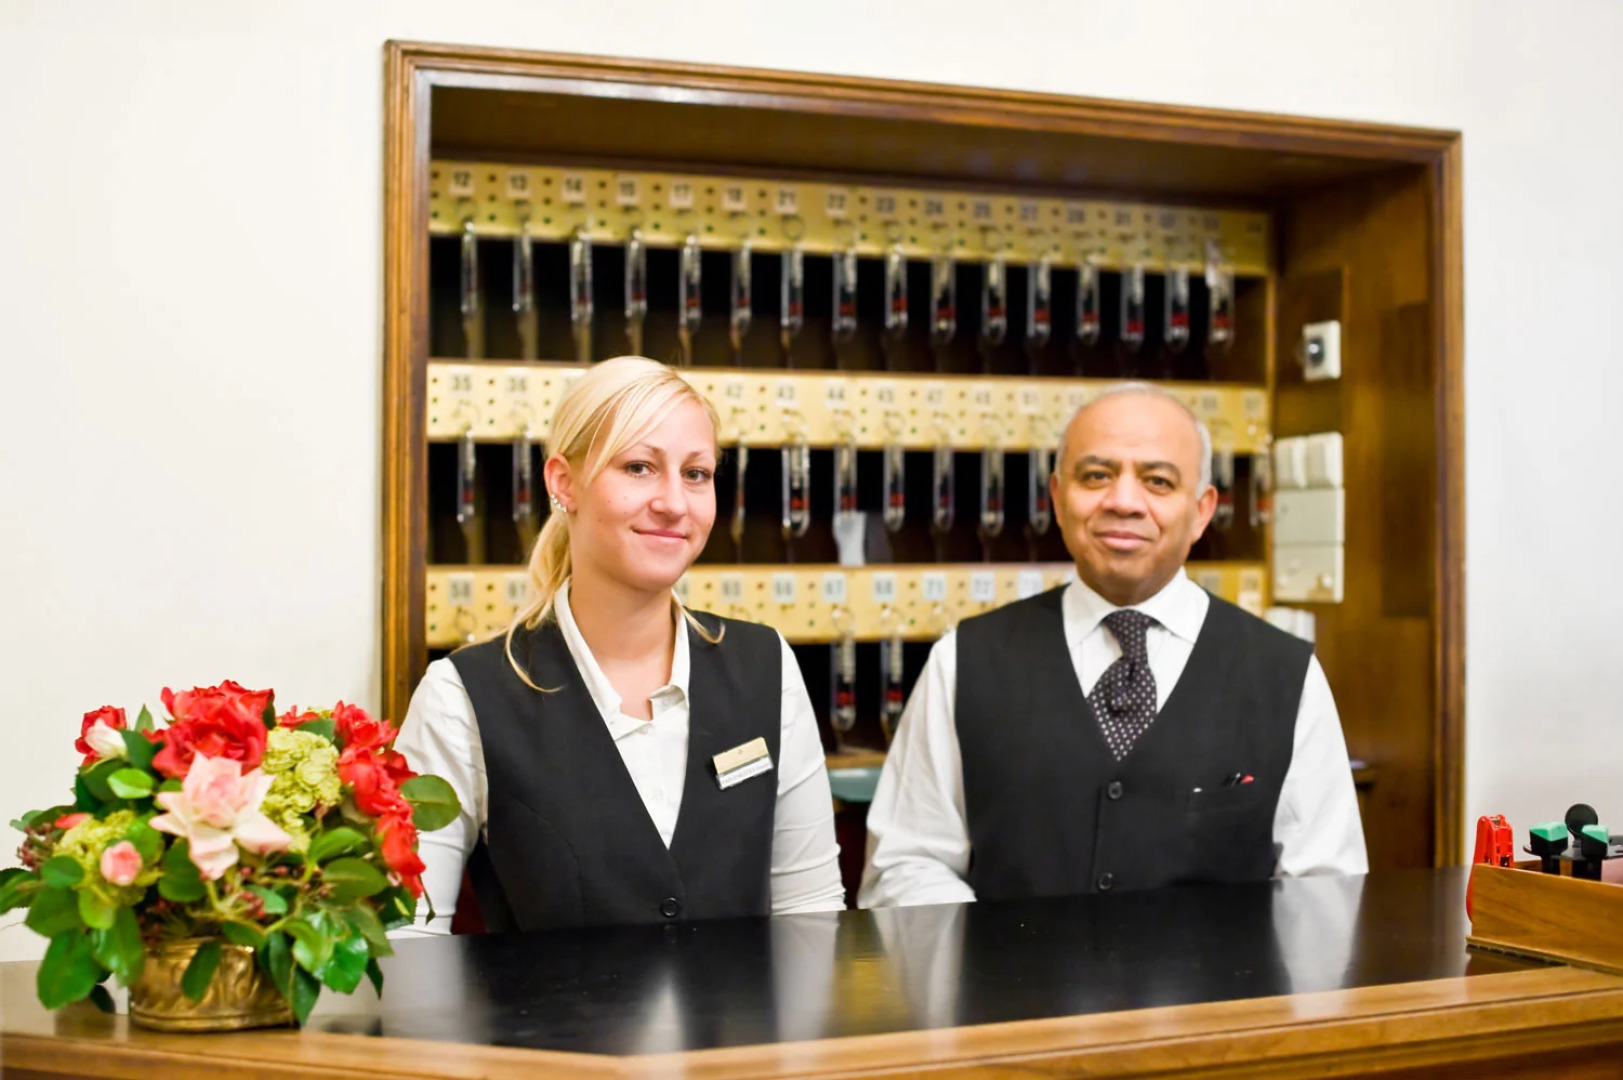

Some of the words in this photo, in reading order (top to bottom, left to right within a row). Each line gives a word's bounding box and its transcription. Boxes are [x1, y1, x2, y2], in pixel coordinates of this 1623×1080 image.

[453, 171, 471, 187] 12
[510, 174, 528, 190] 13
[565, 177, 582, 192] 14
[452, 374, 472, 391] 35
[726, 383, 744, 399] 42
[827, 384, 845, 401] 44
